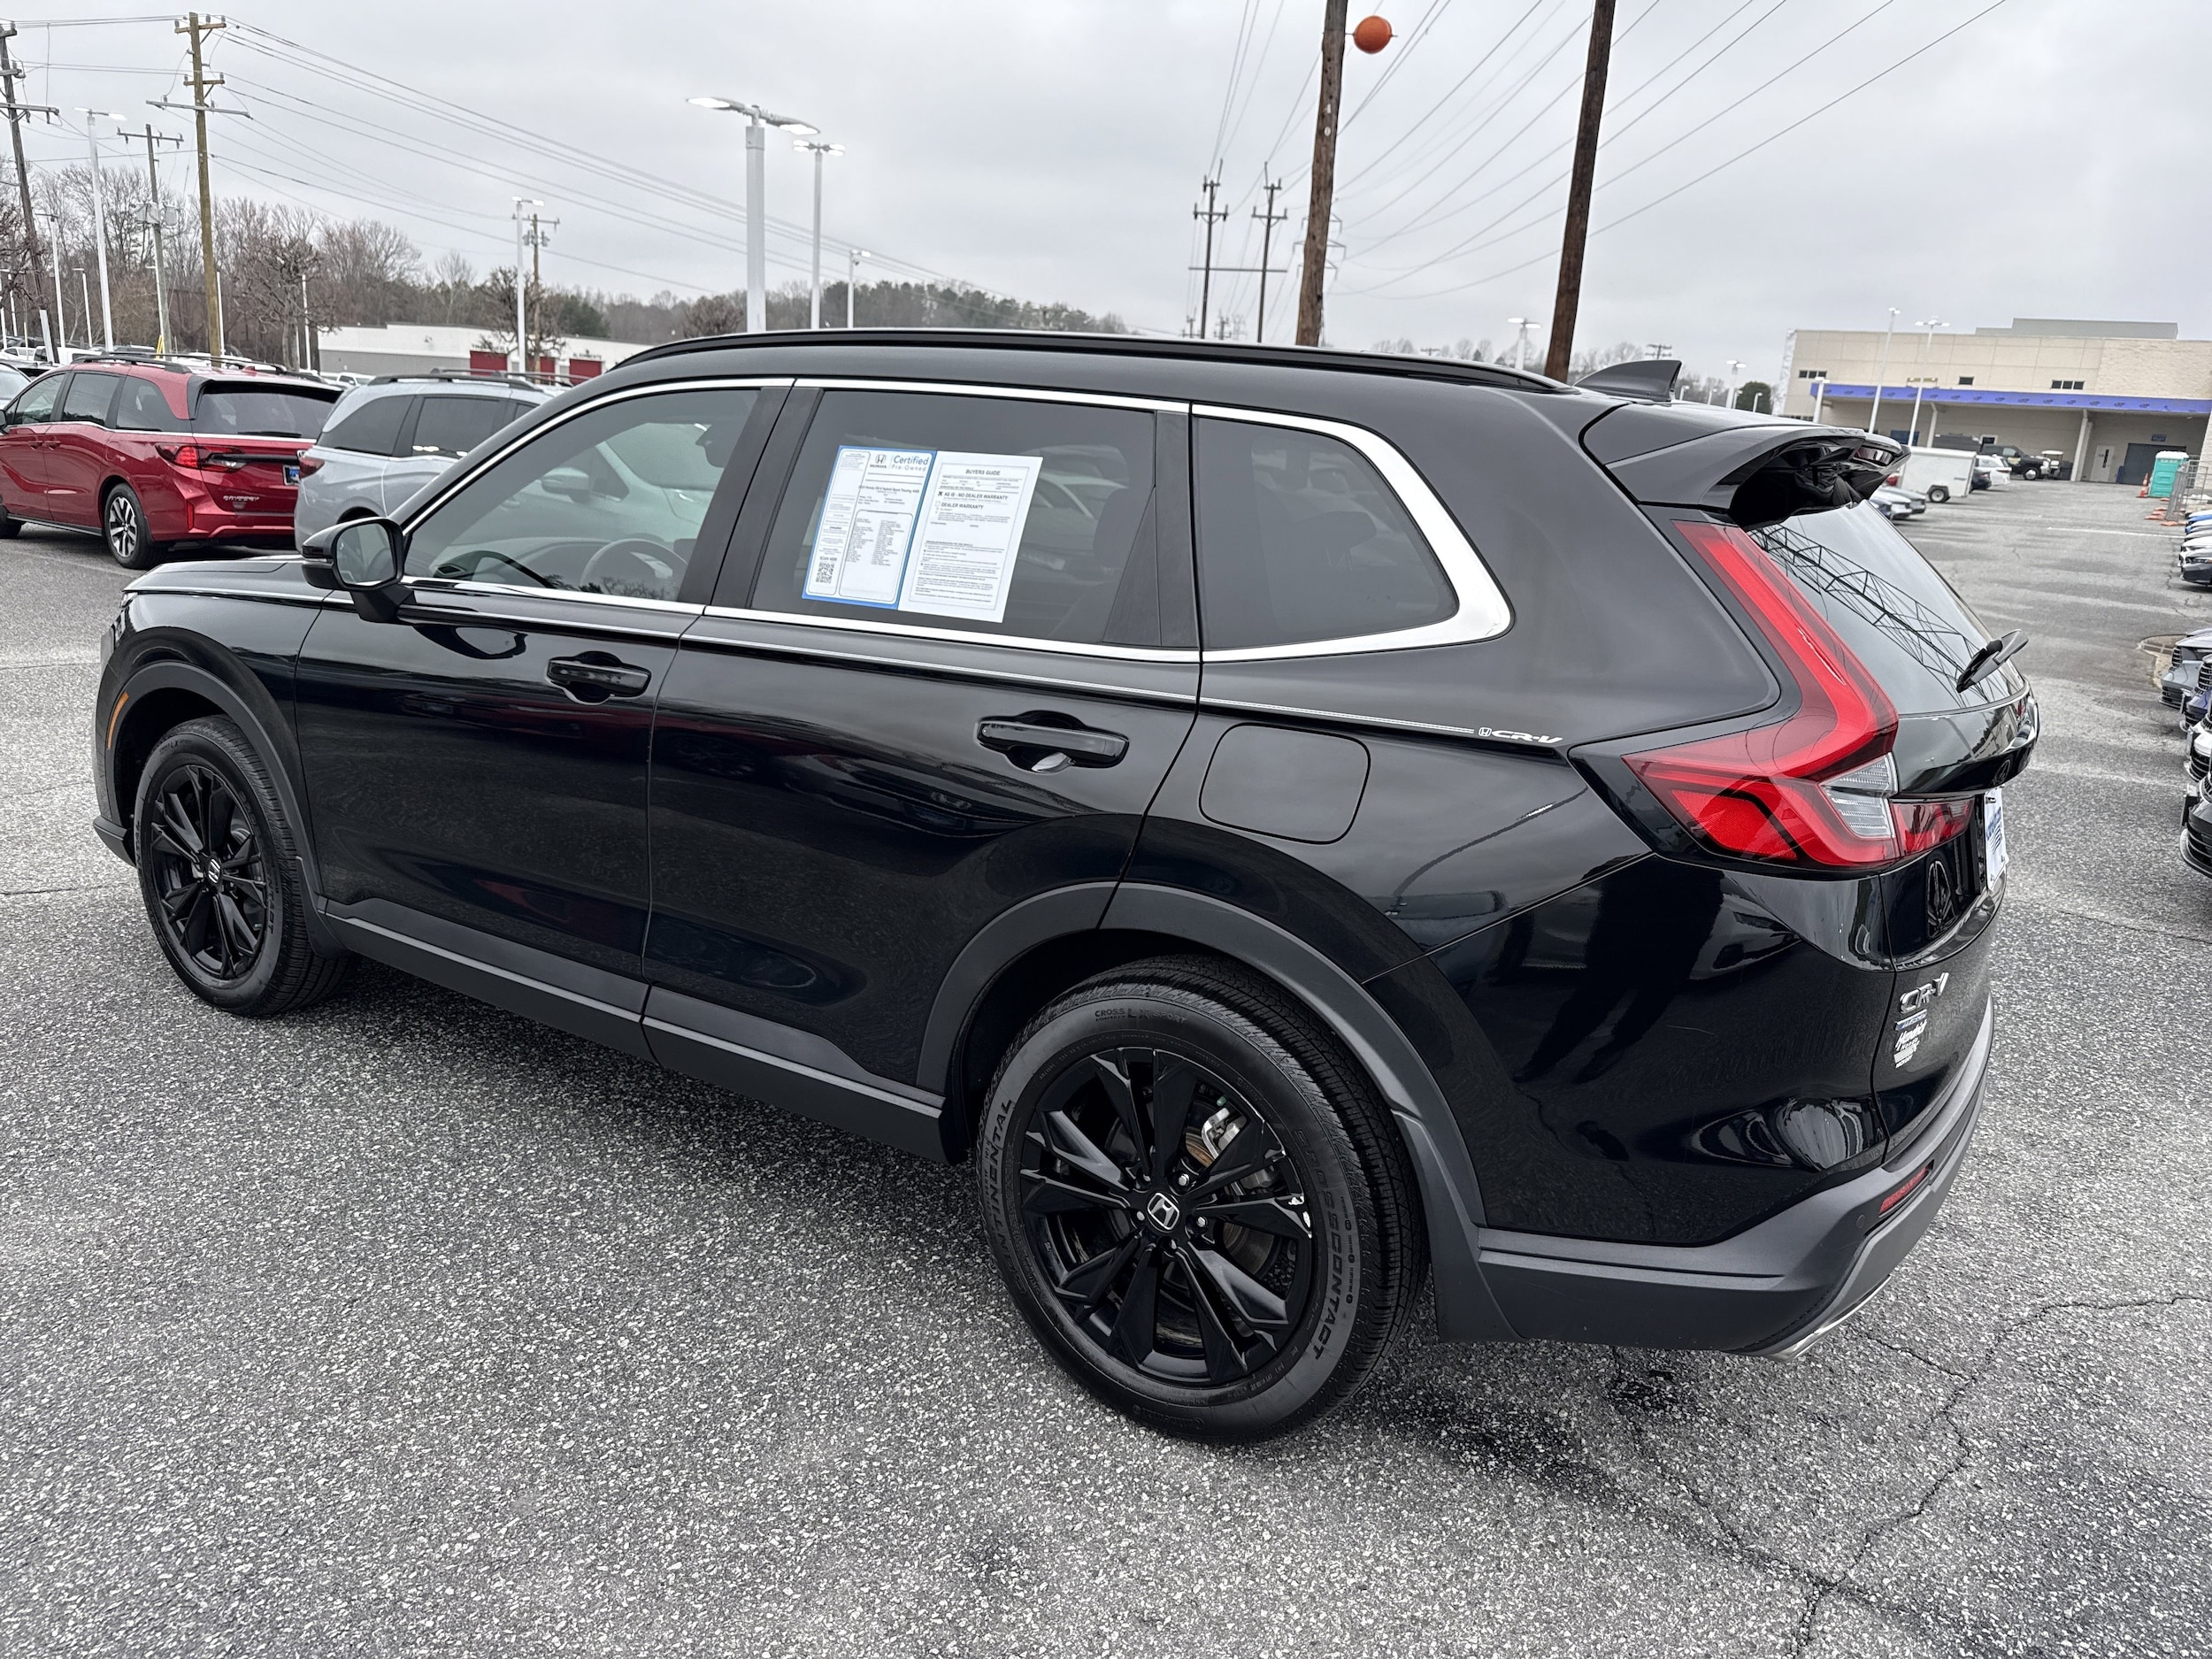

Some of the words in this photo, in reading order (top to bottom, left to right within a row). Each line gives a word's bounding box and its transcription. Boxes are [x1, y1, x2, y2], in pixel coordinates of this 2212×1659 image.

[894, 455, 929, 465] Certified
[1492, 730, 1563, 744] CR-V
[1900, 972, 1949, 1014] CR-V
[1094, 1008, 1125, 1018] CROSS
[1152, 1010, 1187, 1025] SPORT
